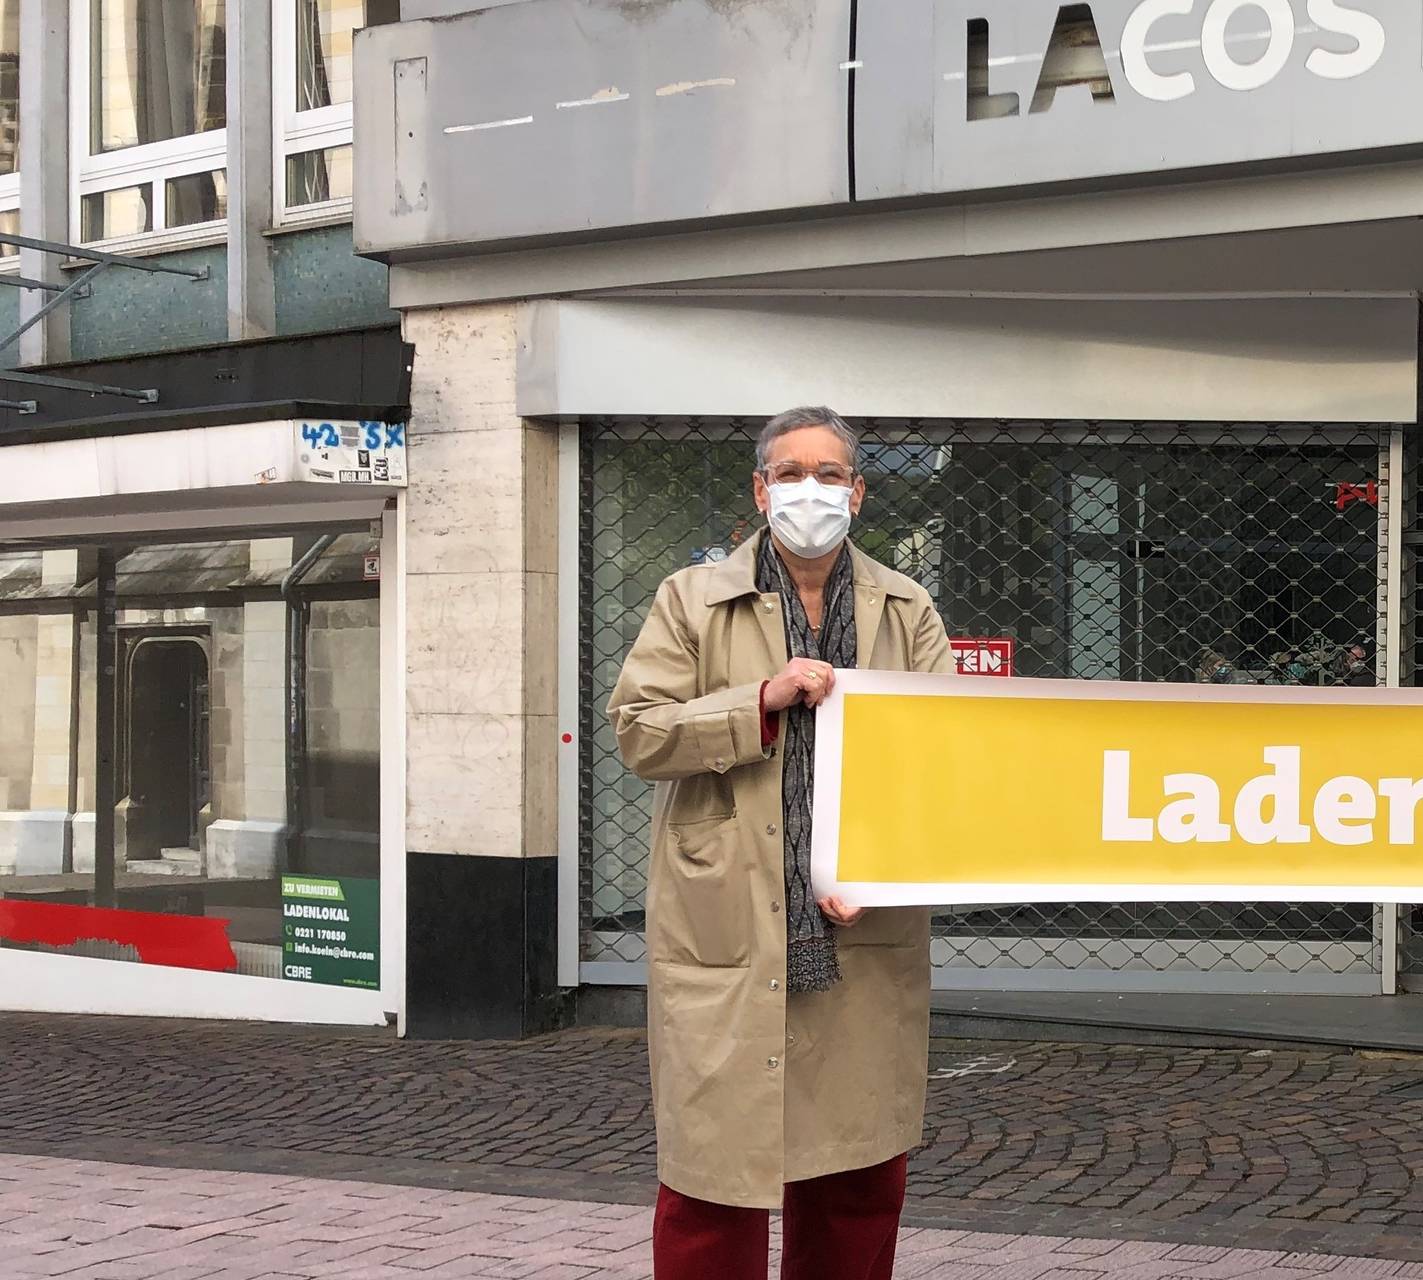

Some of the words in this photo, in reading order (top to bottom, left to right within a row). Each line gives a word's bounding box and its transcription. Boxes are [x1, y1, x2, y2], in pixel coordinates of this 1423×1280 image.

[284, 883, 294, 892] ZU
[296, 884, 338, 896] VERMIETEN
[283, 903, 350, 922] LADENLOKAL
[295, 927, 314, 938] 0221
[317, 929, 346, 941] 170850
[285, 965, 312, 979] CBRE
